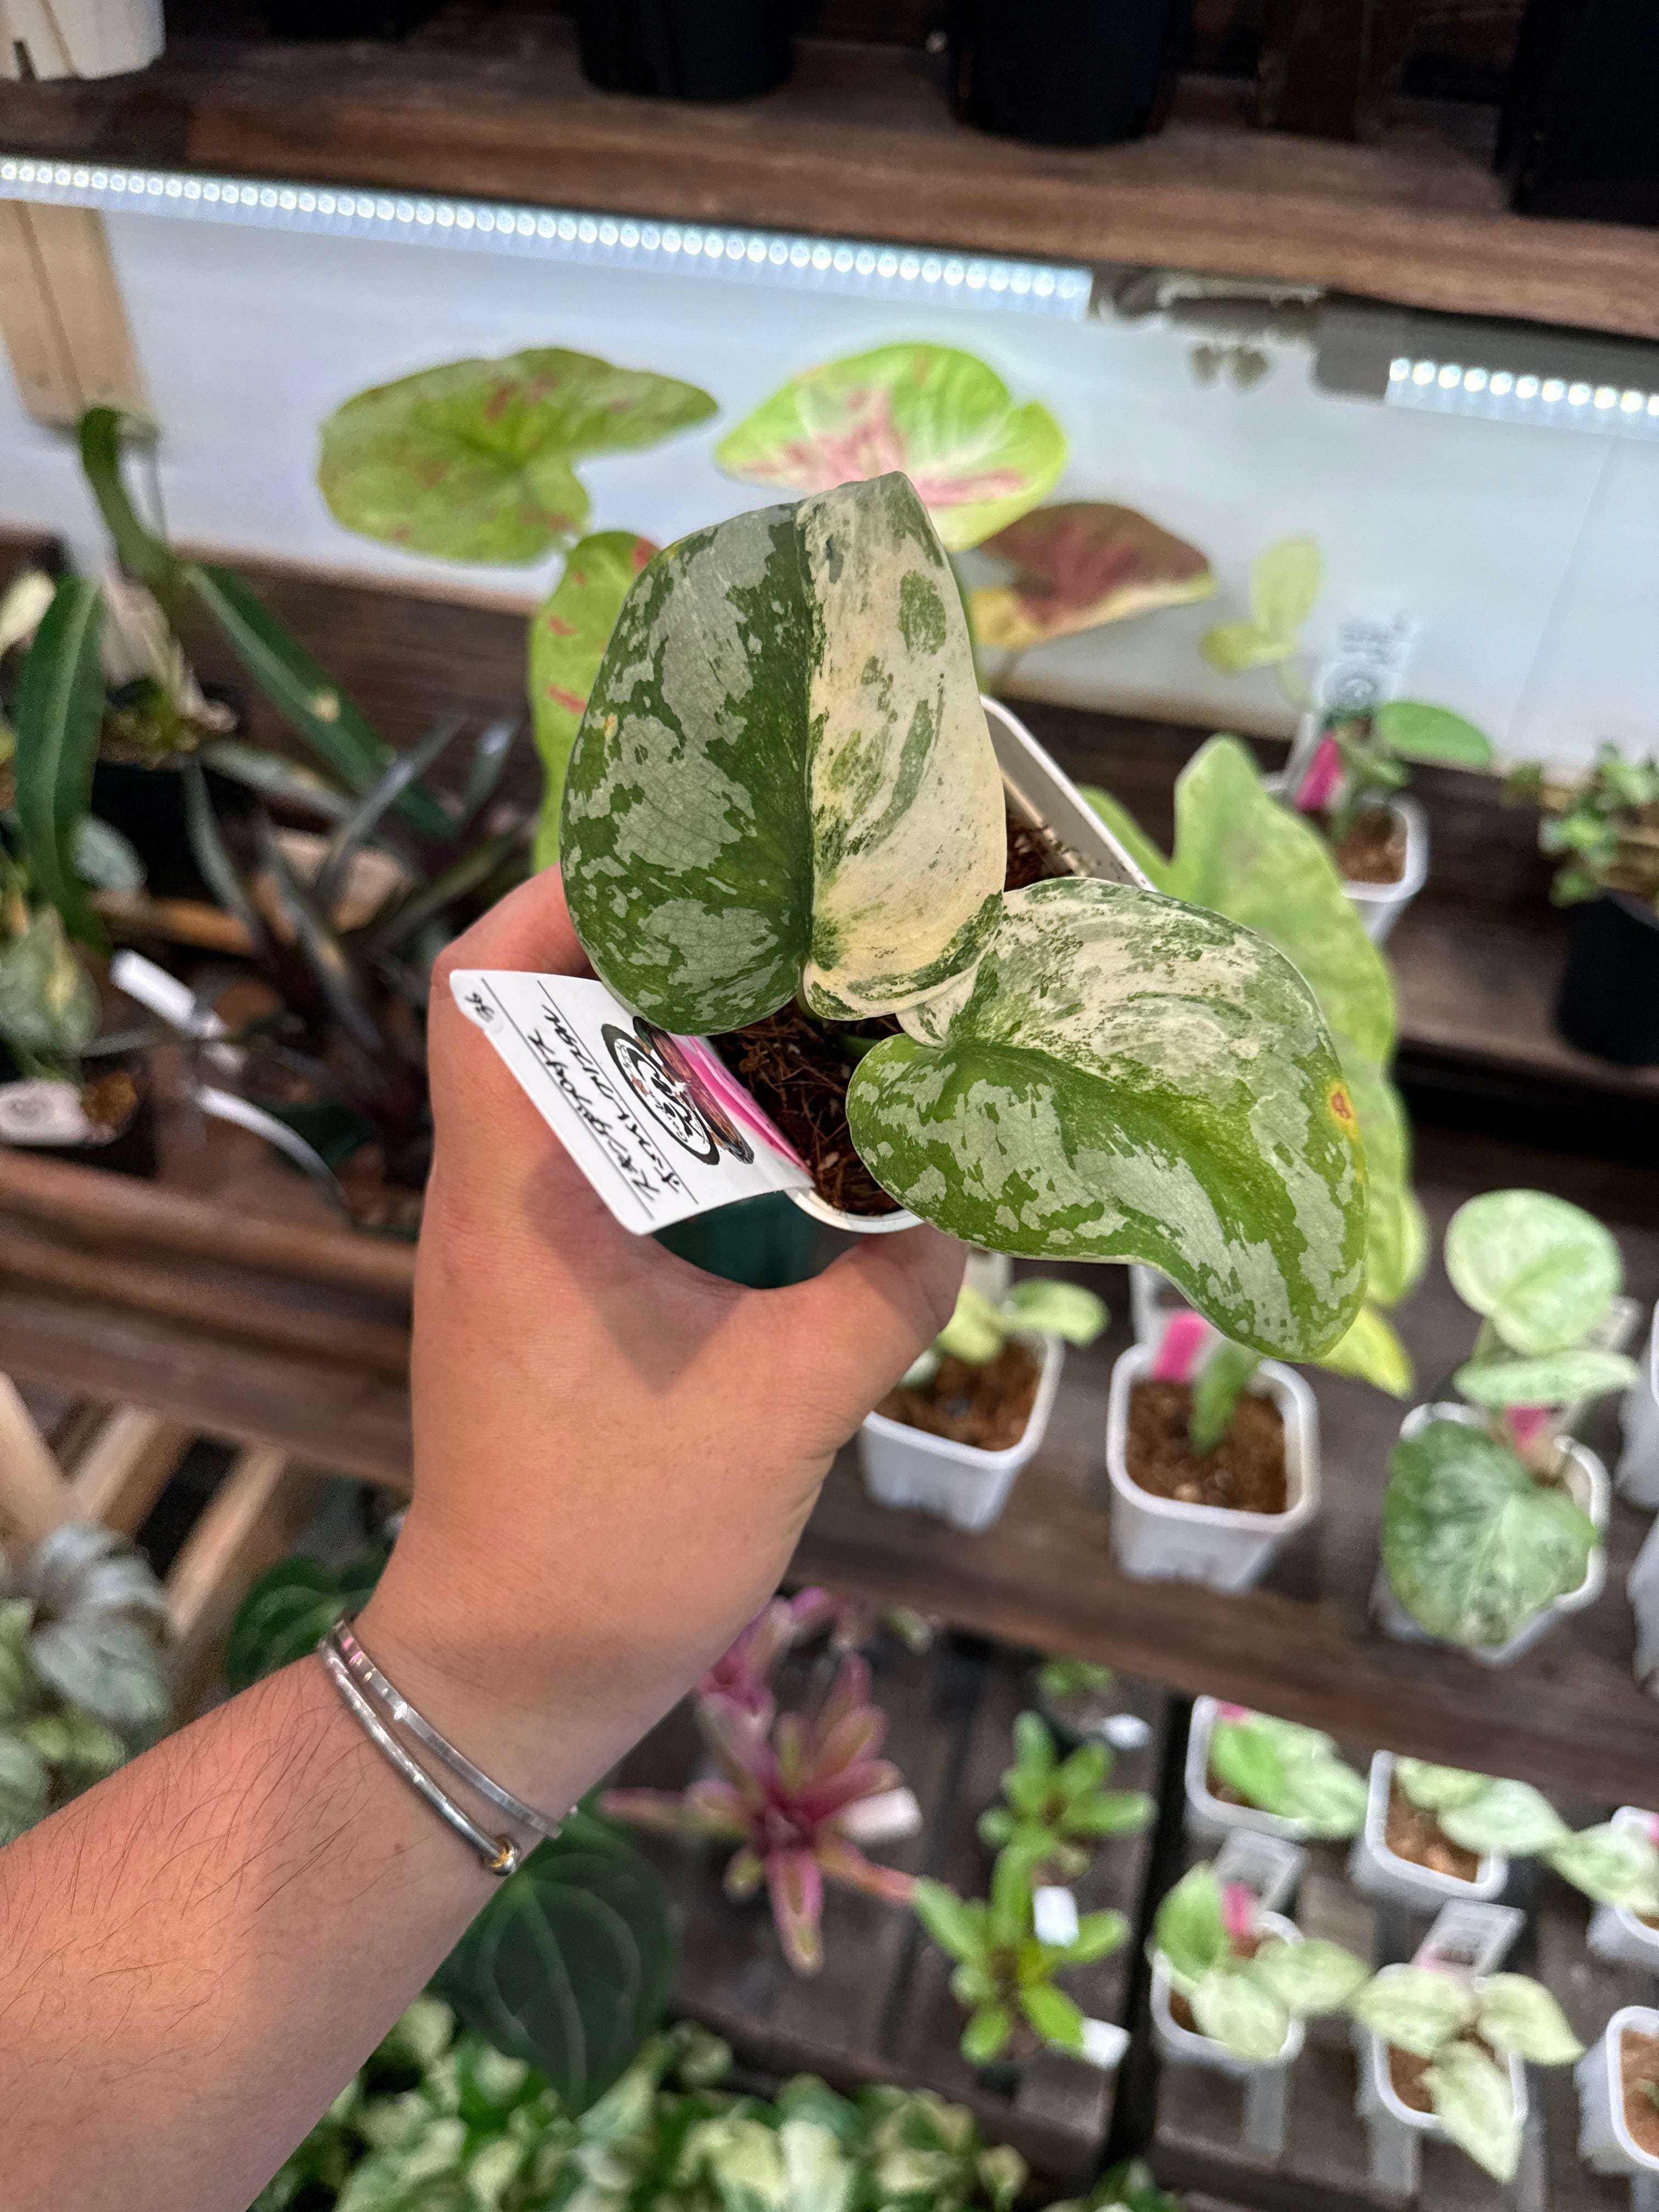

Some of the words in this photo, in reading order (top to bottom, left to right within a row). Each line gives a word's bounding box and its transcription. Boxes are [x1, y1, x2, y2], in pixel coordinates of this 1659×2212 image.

[541, 1004, 680, 1193] ホワイトクリスタル
